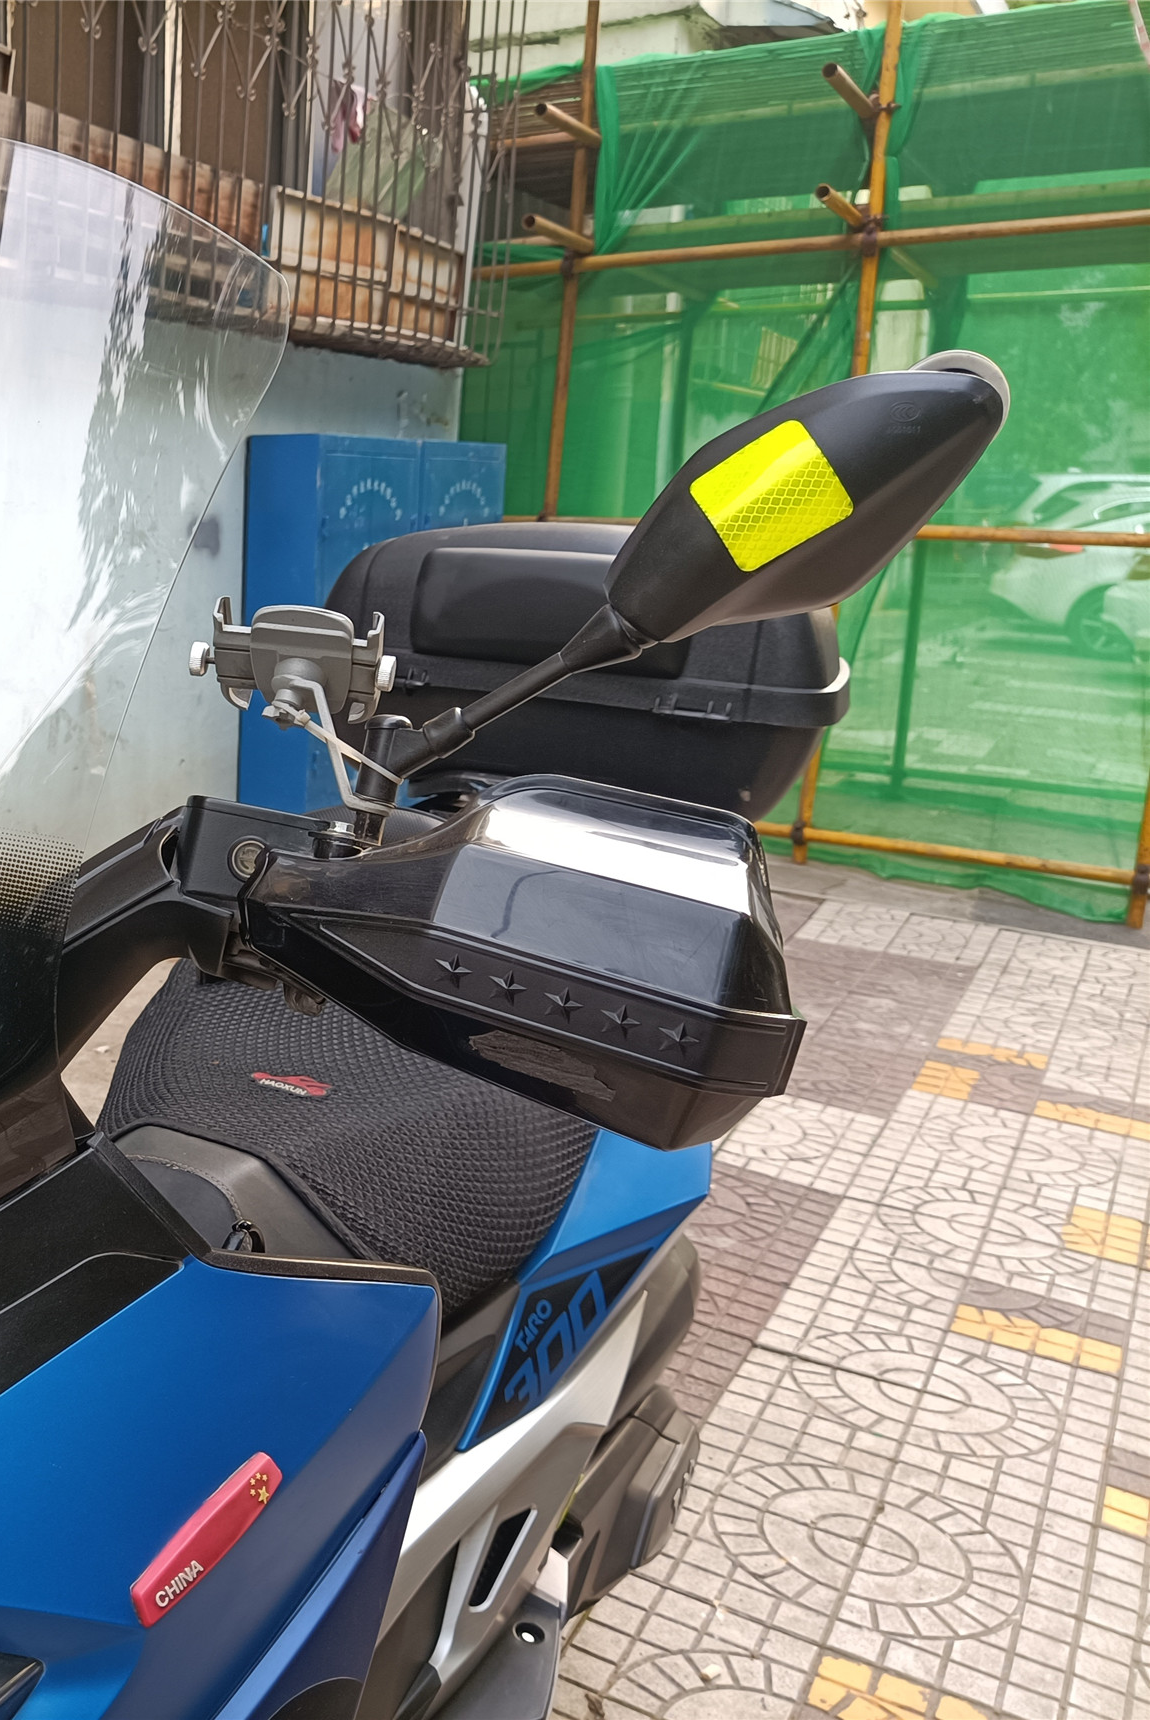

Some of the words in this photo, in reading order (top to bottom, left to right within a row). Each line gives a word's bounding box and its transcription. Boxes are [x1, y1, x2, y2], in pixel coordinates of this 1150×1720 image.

[259, 1078, 308, 1096] HAOXUN
[504, 1270, 609, 1414] 300
[514, 1299, 553, 1353] TARO
[154, 1559, 205, 1609] CHINA
